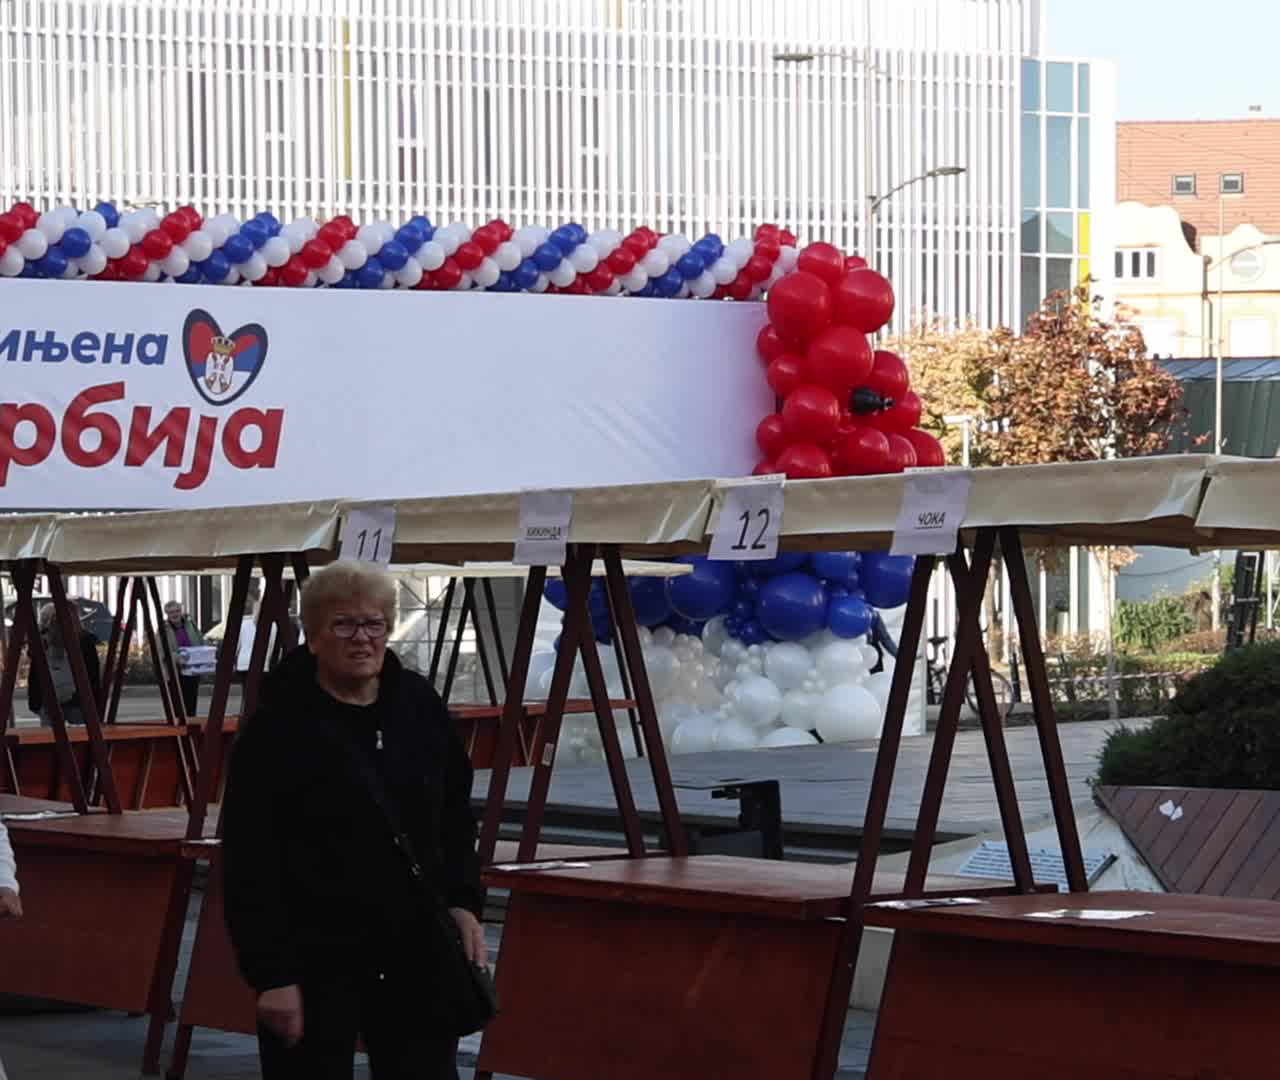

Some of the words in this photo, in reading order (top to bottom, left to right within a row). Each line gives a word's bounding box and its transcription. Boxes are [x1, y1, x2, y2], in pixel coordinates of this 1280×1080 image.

[731, 508, 770, 550] 12
[918, 511, 946, 526] ЧОКА
[357, 528, 383, 561] 11
